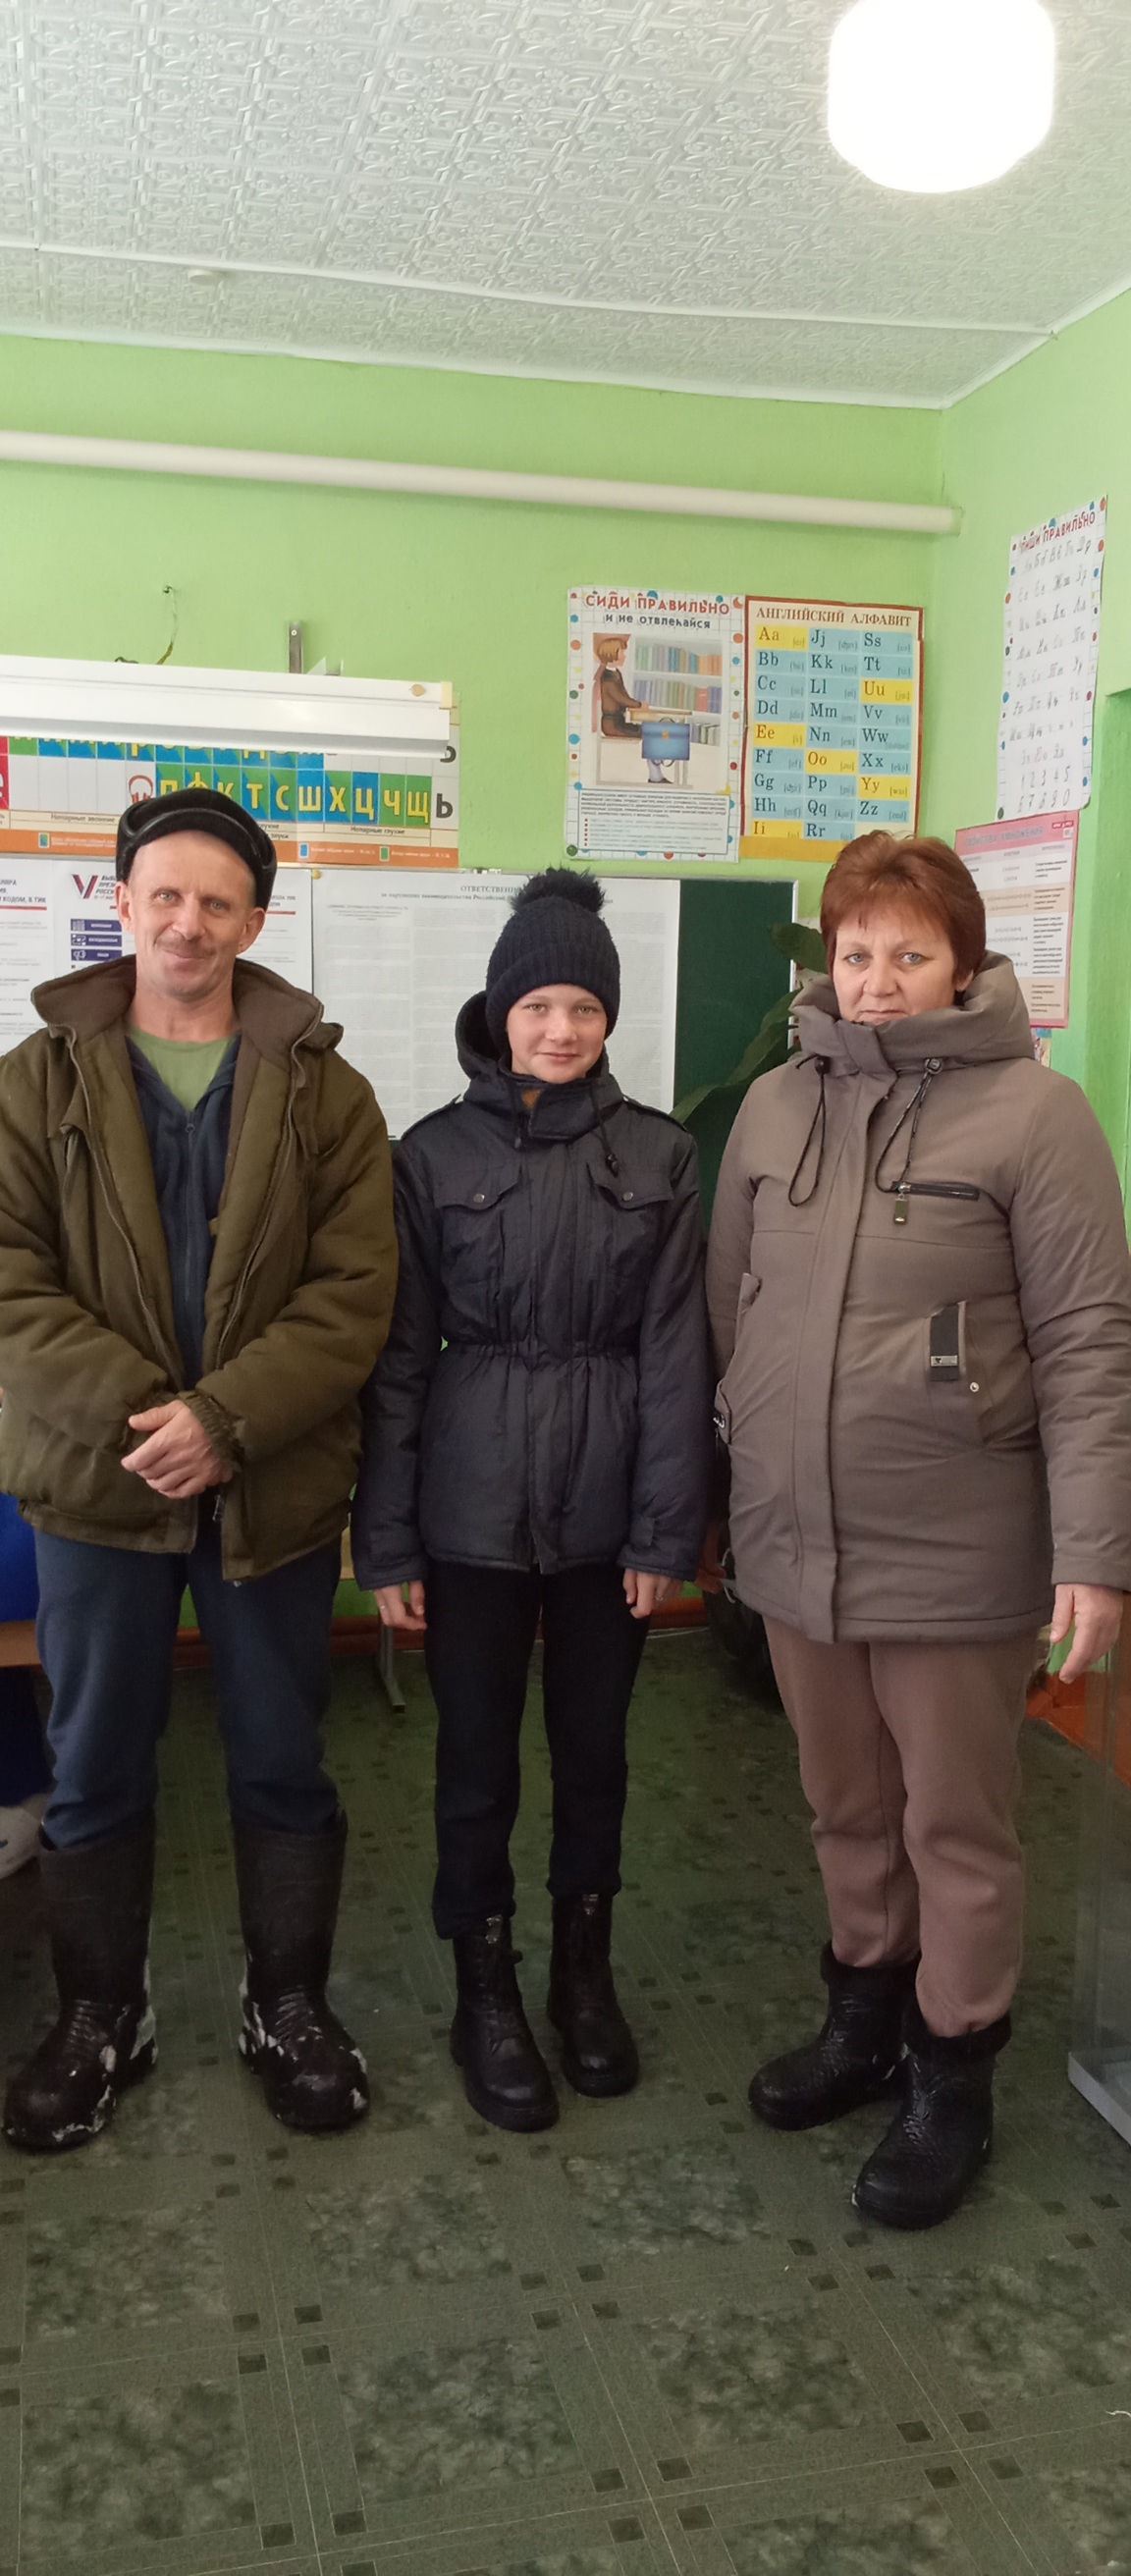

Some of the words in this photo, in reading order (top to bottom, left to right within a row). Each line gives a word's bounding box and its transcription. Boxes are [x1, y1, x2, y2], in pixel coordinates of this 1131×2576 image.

[1043, 511, 1096, 543] ПРАВИЛЬНО
[586, 595, 630, 609] СИДИ
[638, 597, 729, 615] ПРАВИЛЬНО
[757, 607, 844, 623] АНГЛИЙСКИЙ
[850, 614, 911, 626] АЛФАВИТ
[759, 626, 780, 641] Aa
[811, 629, 825, 648] Jj
[864, 632, 882, 647] Ss
[759, 652, 779, 666] Bb
[811, 654, 833, 669] Kk
[864, 656, 881, 671] Tt
[757, 675, 777, 690] Cc
[864, 681, 885, 696] Uu
[757, 700, 779, 715] Dd
[810, 703, 837, 718] Mm
[864, 705, 883, 720] Vv
[756, 724, 775, 739] Ee
[809, 727, 831, 742] Nn
[862, 728, 889, 743] Ww
[756, 749, 773, 764] Ff
[808, 751, 828, 766] Oo
[754, 774, 775, 791] Gg
[808, 776, 828, 791] Pp
[861, 777, 880, 793] Yy
[755, 797, 777, 812] Hh
[808, 799, 827, 817] Qq
[860, 801, 878, 816] Zz
[806, 823, 826, 837] Rr
